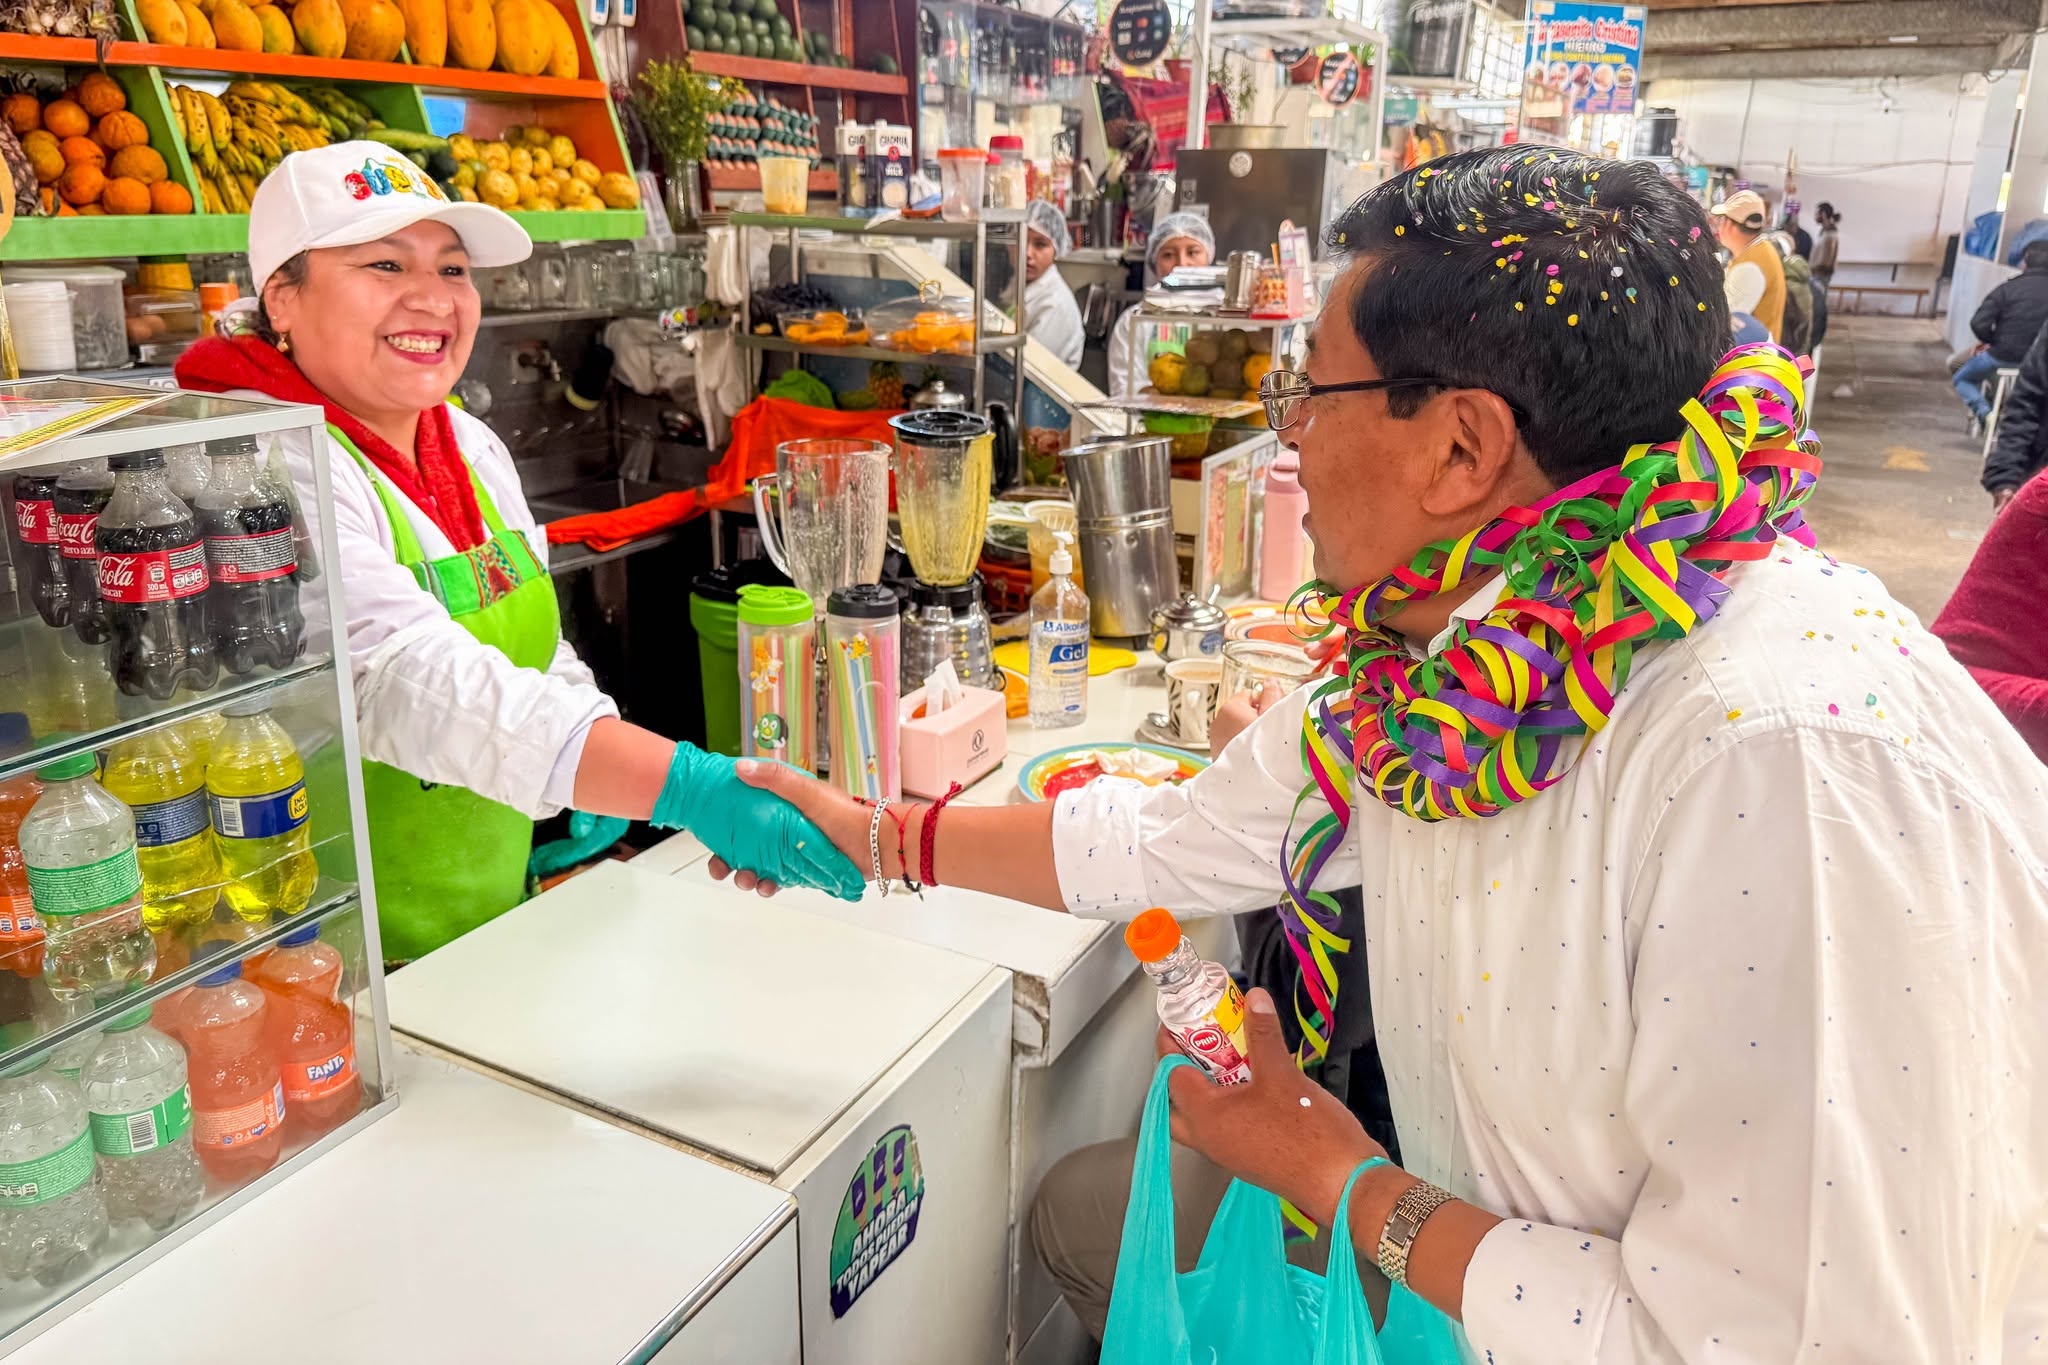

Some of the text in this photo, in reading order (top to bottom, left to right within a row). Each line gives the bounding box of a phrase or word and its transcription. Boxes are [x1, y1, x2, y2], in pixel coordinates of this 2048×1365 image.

[1059, 644, 1086, 662] Gel
[1194, 1034, 1218, 1049] PRIN
[306, 1055, 345, 1081] FANTA
[836, 1195, 919, 1294] TODOS PUEDEN
[852, 1187, 907, 1258] AHORA
[848, 1221, 909, 1300] YAPEAR
